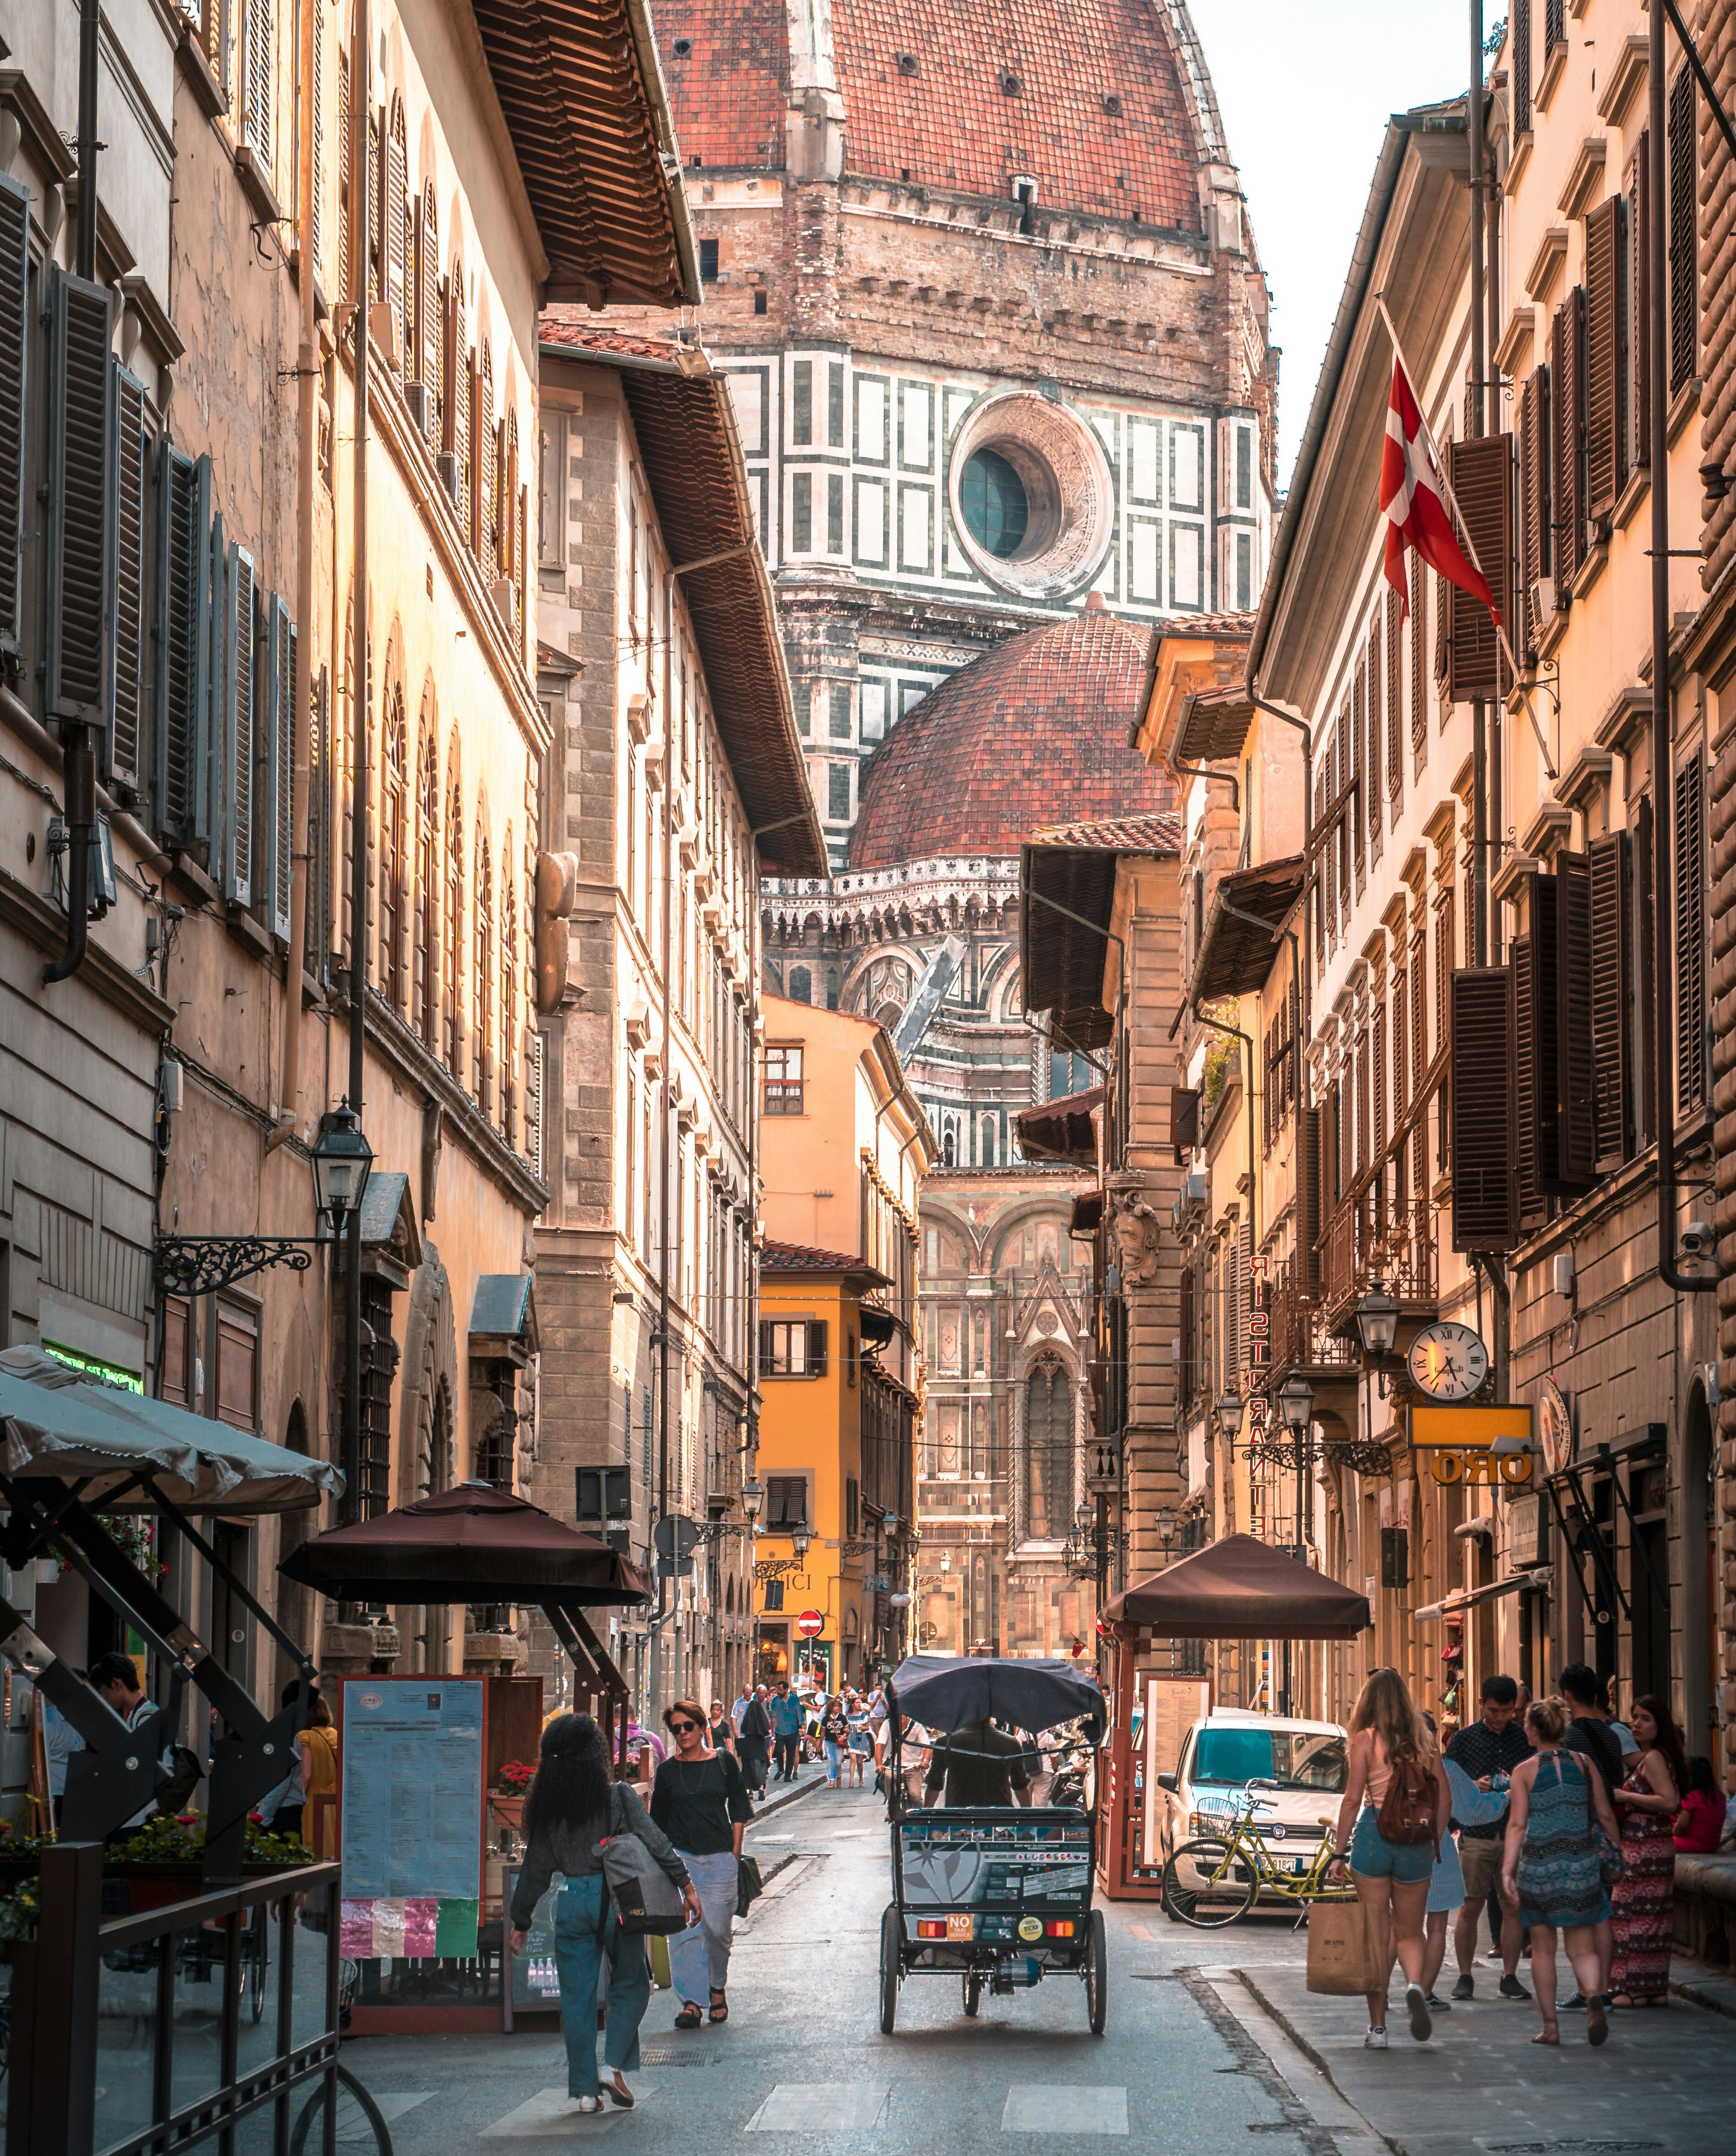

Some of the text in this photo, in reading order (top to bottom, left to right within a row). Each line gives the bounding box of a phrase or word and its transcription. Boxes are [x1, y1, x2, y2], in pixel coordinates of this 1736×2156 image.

[1441, 1329, 1453, 1340] XII
[1445, 1384, 1454, 1394] VI
[949, 1917, 970, 1928] NO
